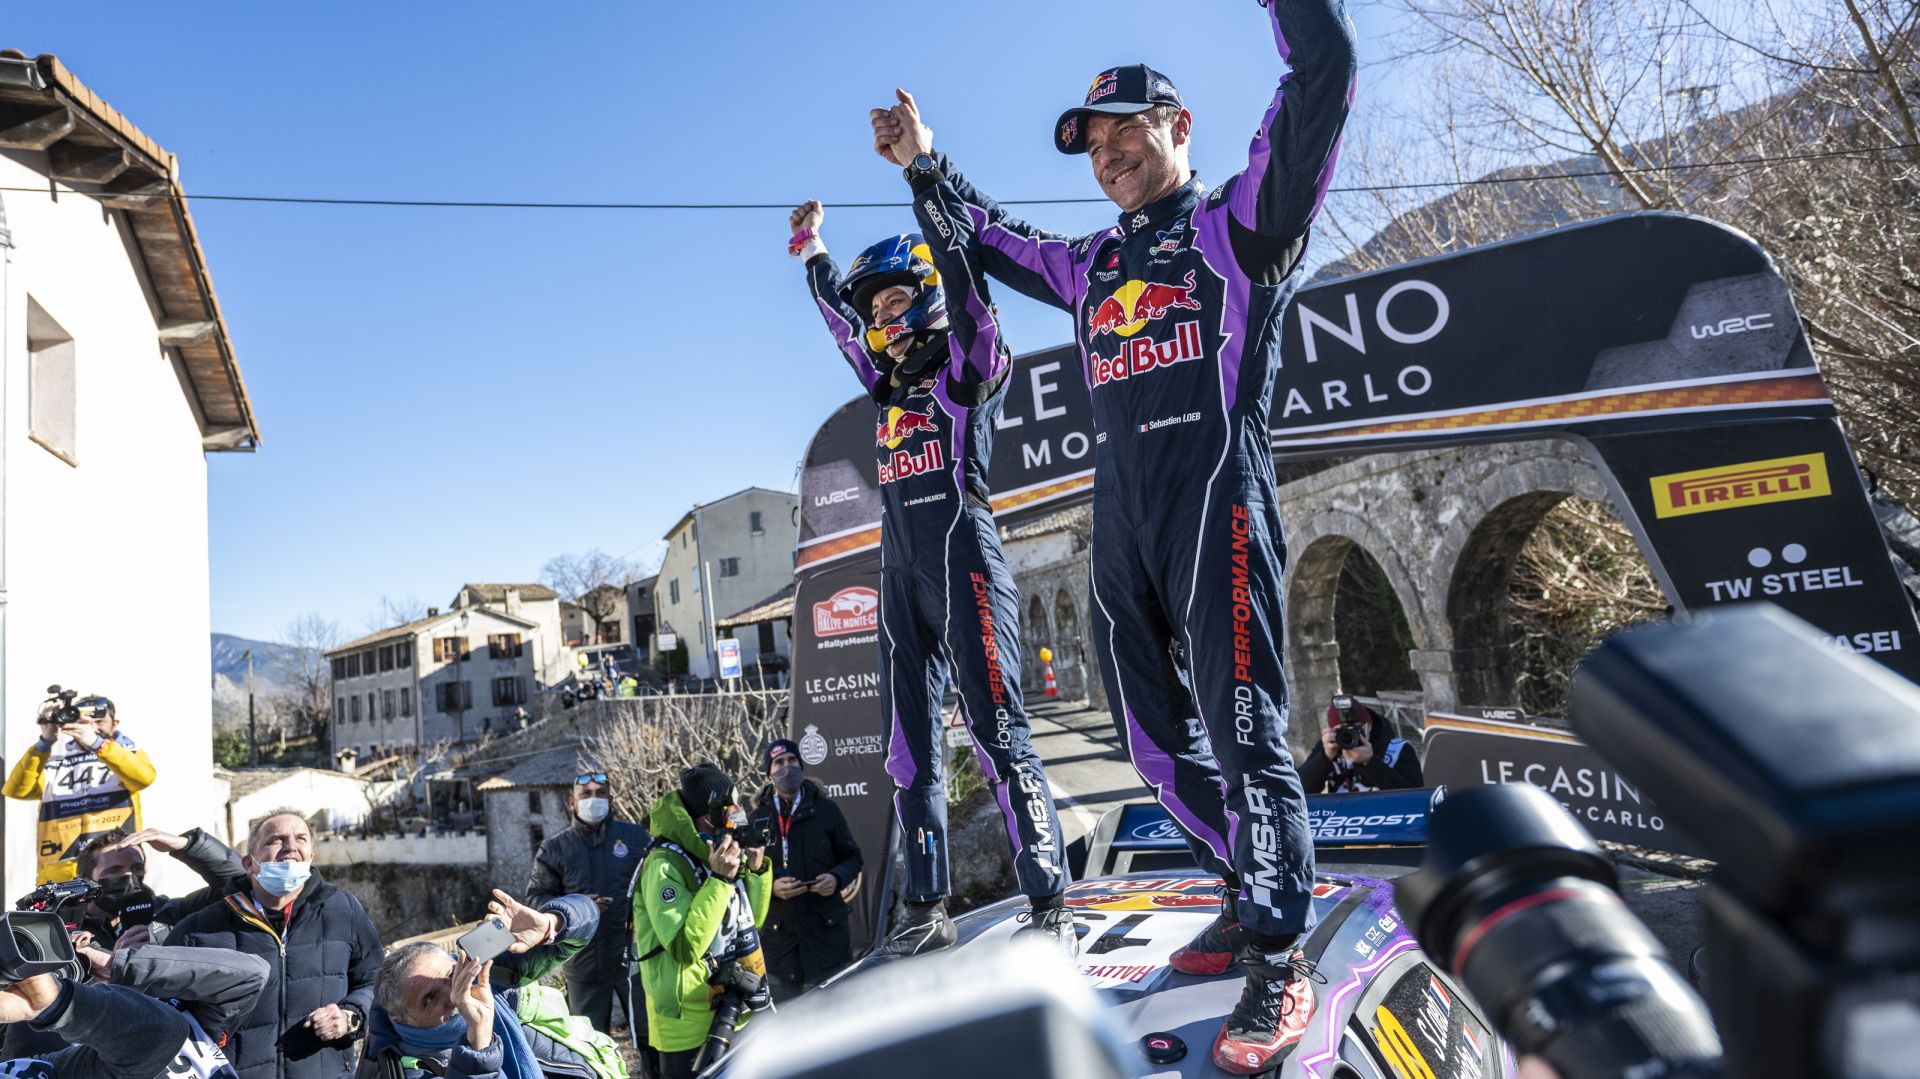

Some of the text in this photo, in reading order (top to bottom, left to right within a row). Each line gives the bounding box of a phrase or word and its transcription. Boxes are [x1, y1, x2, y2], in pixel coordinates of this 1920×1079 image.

[924, 200, 951, 239] sparco
[1691, 313, 1774, 339] WRC
[1091, 320, 1204, 389] Red Bull
[1282, 365, 1432, 418] ARLO
[1149, 412, 1201, 430] Sebastien LOEB
[877, 440, 945, 486] ed Bull
[815, 487, 859, 507] WRC
[1668, 463, 1811, 508] PIRELLI
[1705, 566, 1863, 601] TW STEEL
[1231, 504, 1255, 746] FORD PERFORMANCE
[817, 633, 878, 649] #RallyeMonteC
[1830, 630, 1901, 654] ASEI
[805, 672, 880, 694] LE CASIN
[835, 735, 882, 747] LA BOUTIQ
[835, 743, 882, 757] OFFICIEL
[58, 766, 110, 790] 447
[1481, 759, 1641, 804] LE CASIN
[102, 815, 121, 824] 2022
[1322, 810, 1337, 818] by
[1270, 797, 1283, 860] TECHNOLOGY
[1084, 965, 1157, 983] RALLYE
